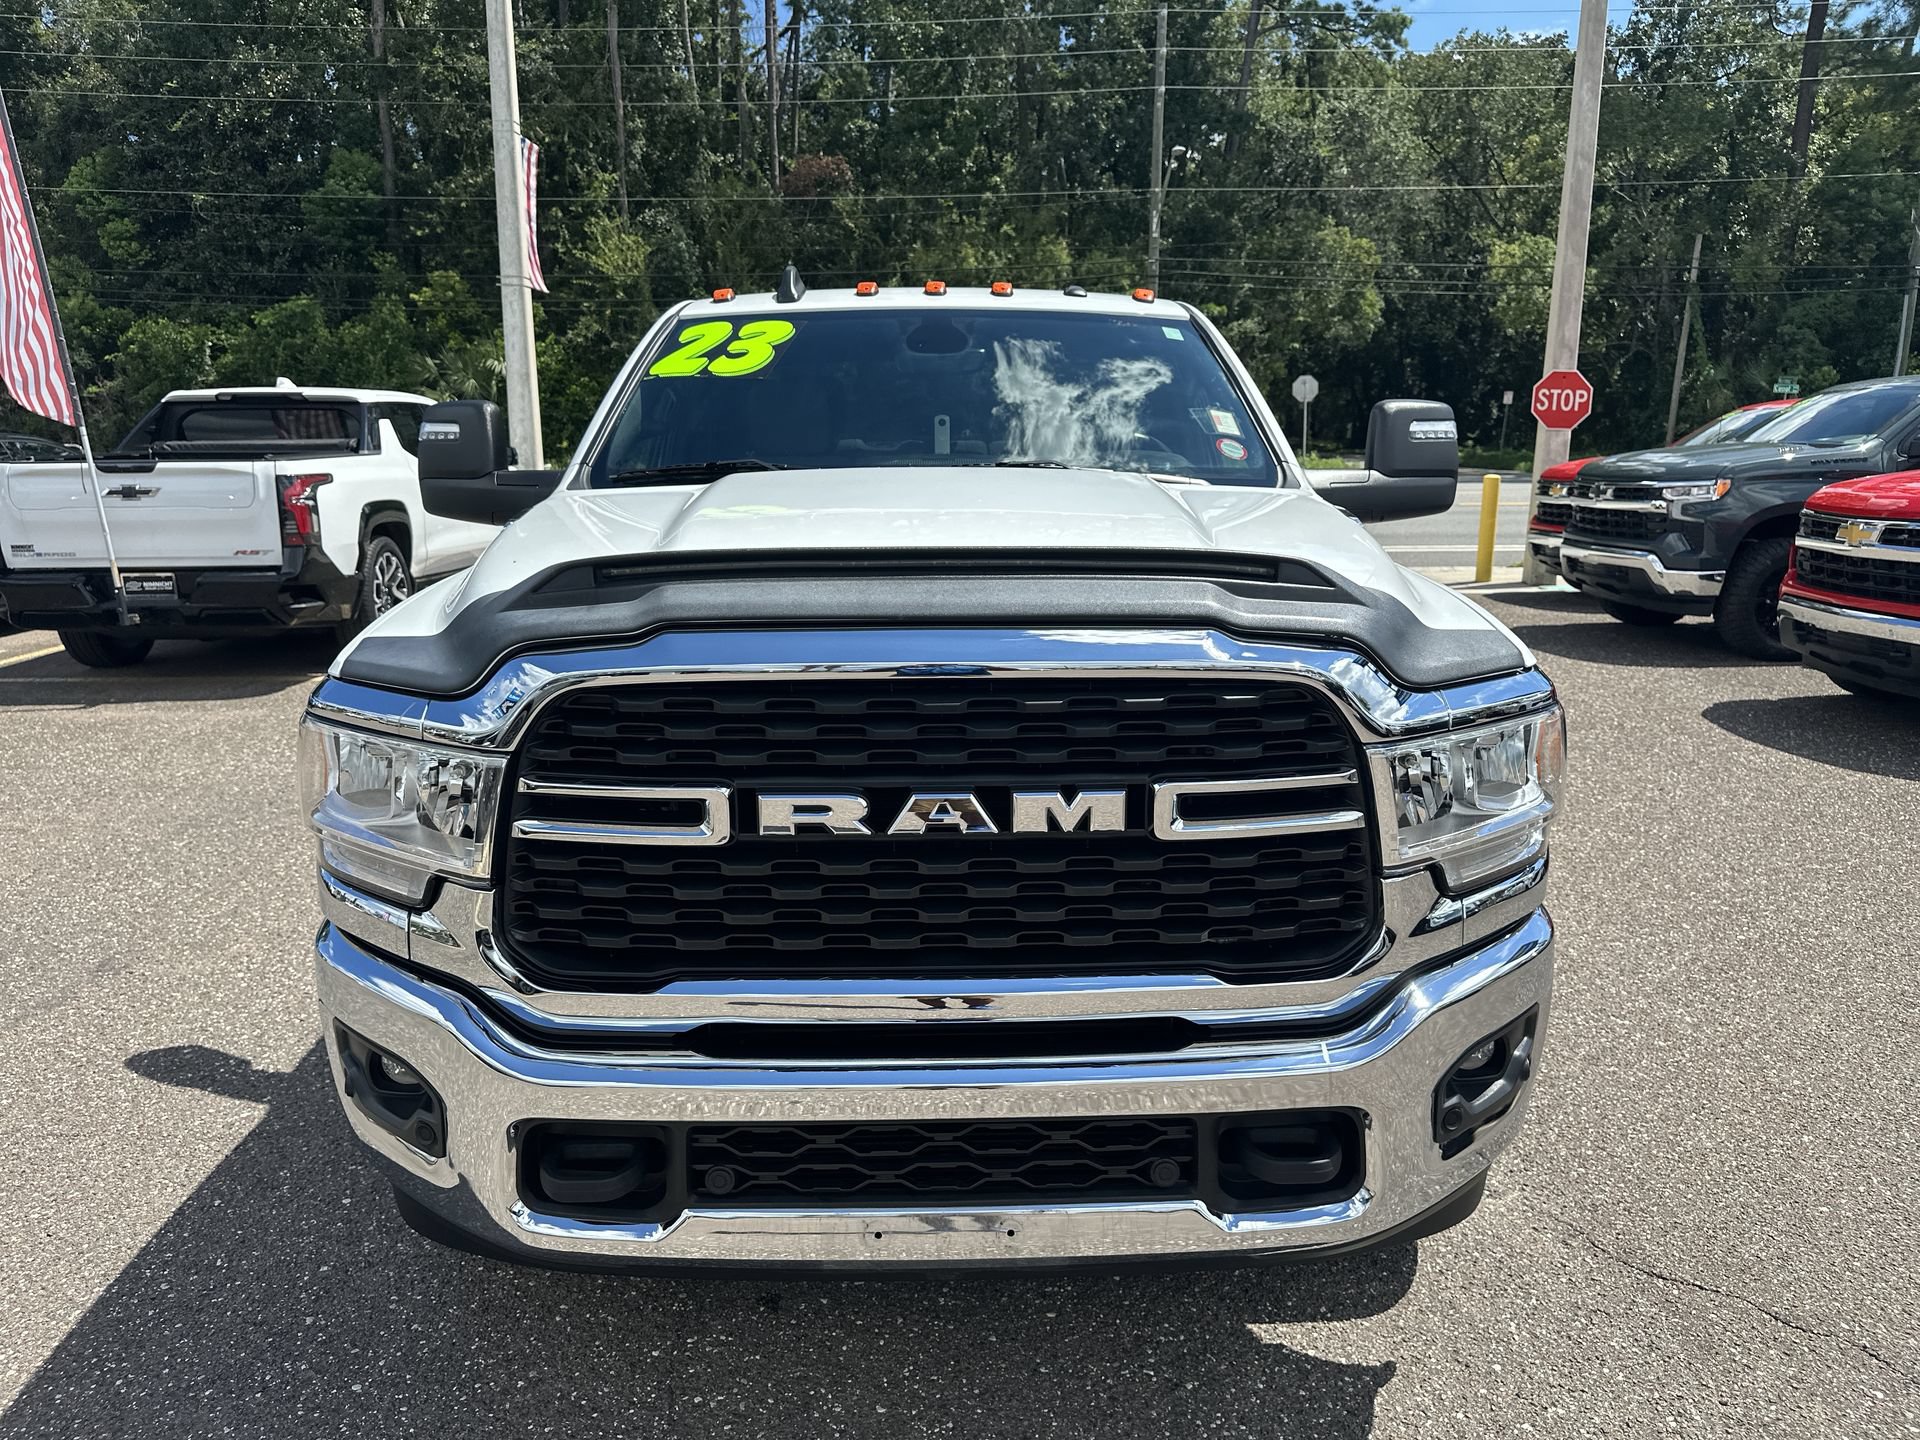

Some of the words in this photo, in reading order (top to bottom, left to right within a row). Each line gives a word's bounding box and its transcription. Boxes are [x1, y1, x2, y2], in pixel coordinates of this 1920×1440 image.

[649, 320, 796, 377] 23
[1536, 388, 1588, 412] STOP
[757, 791, 1127, 836] RAM
